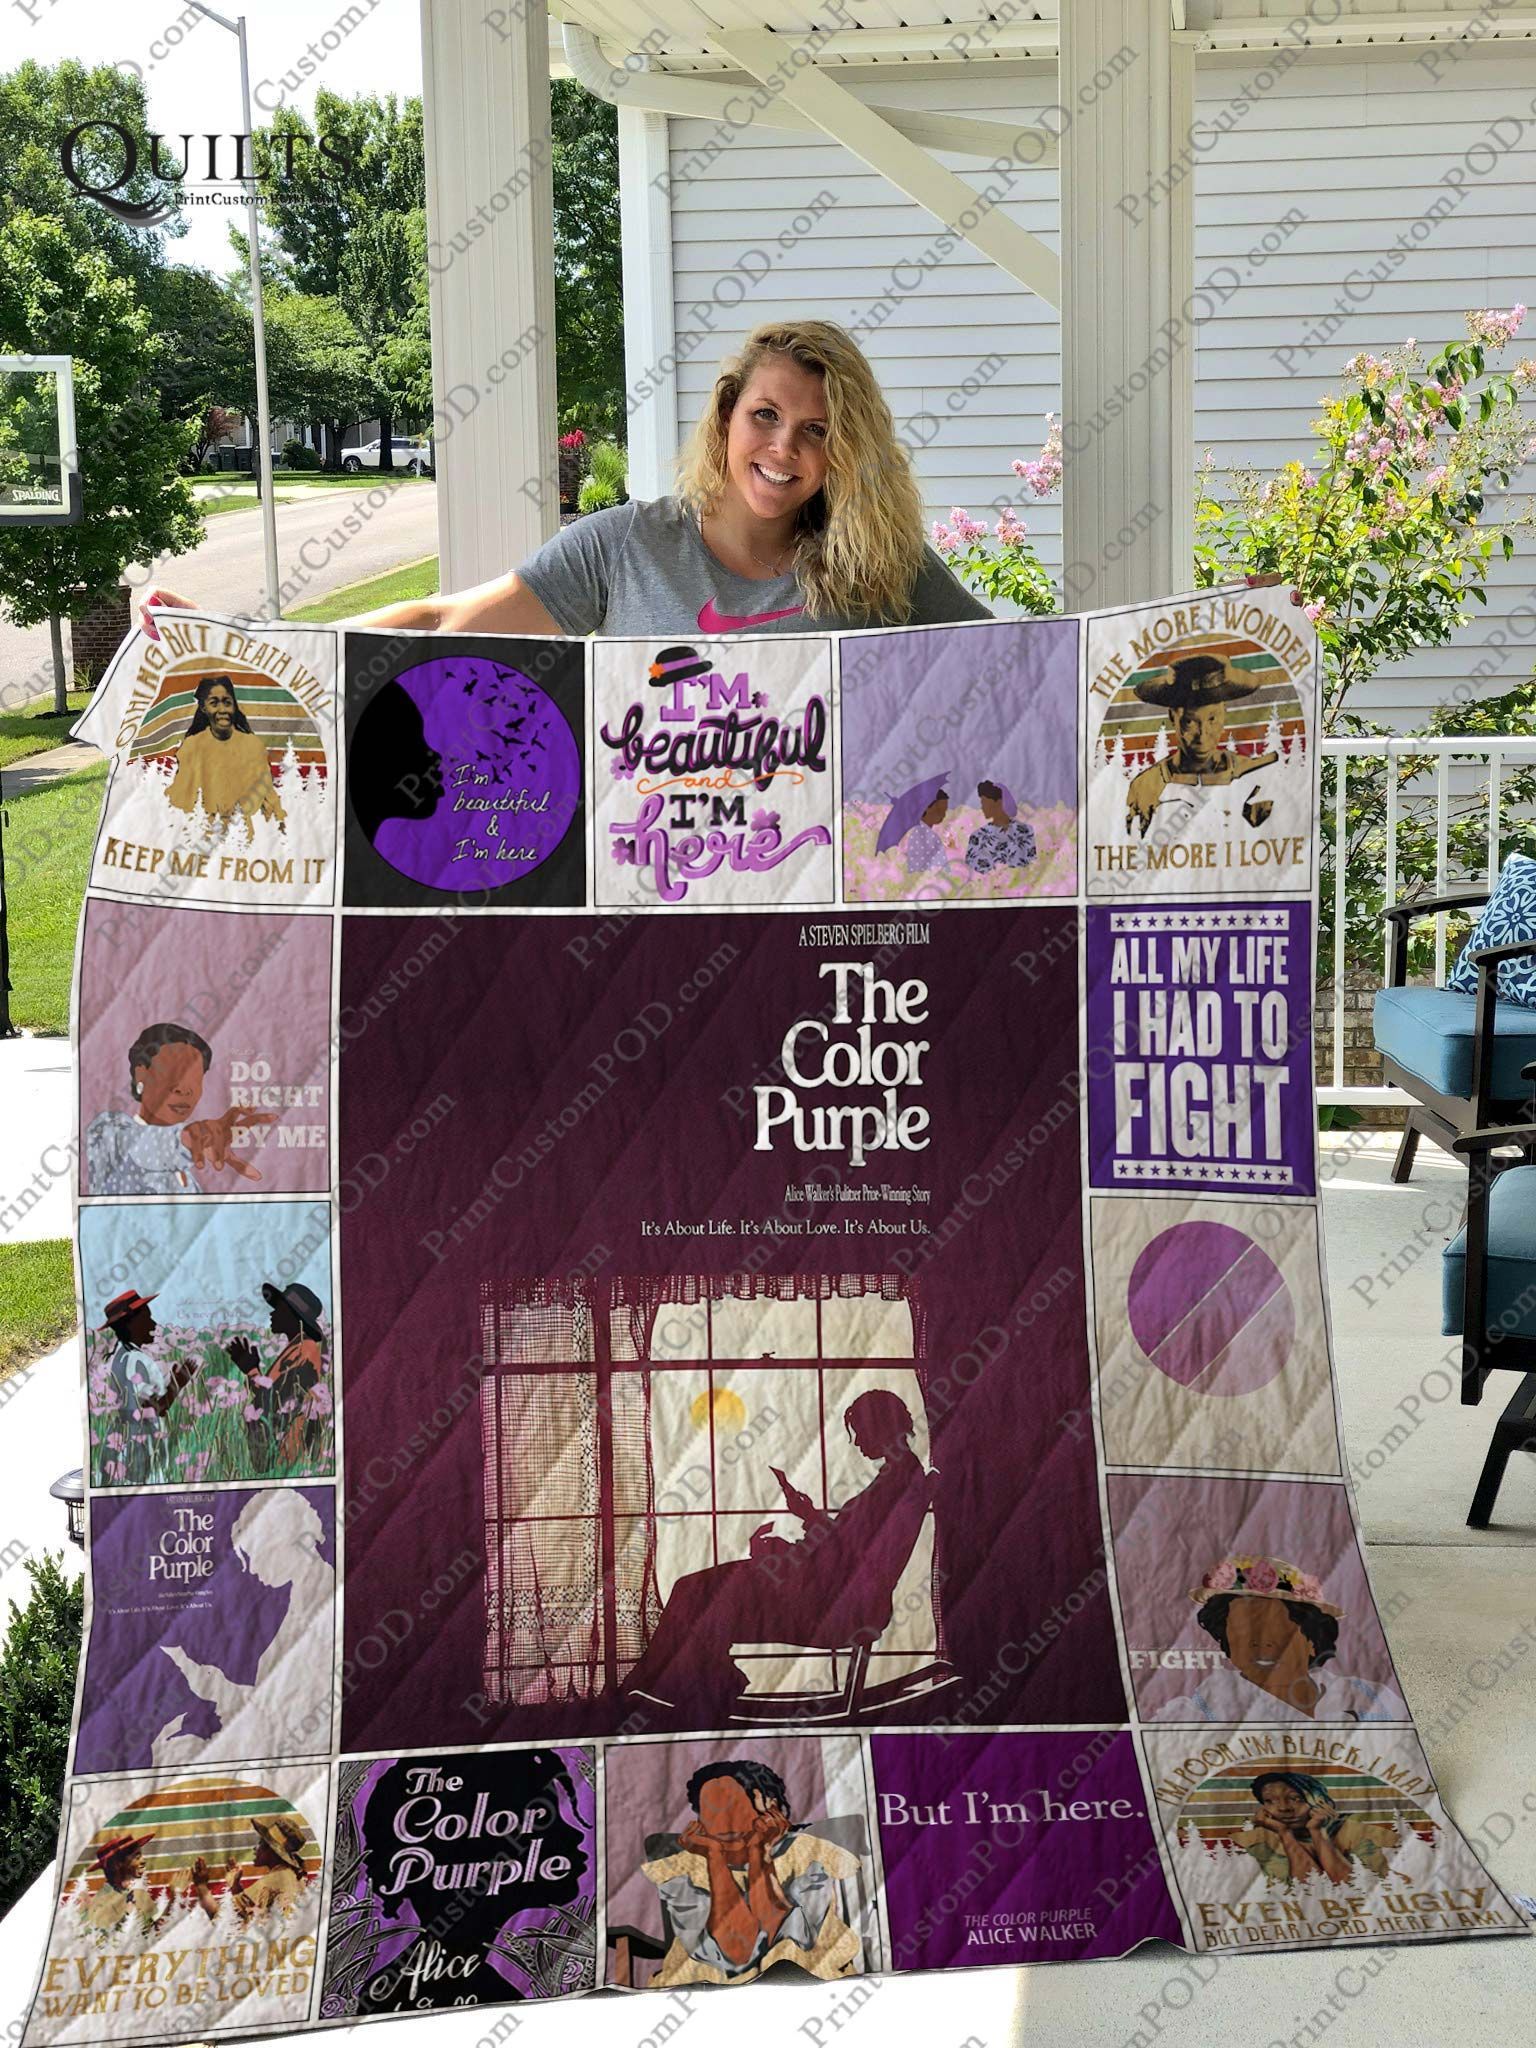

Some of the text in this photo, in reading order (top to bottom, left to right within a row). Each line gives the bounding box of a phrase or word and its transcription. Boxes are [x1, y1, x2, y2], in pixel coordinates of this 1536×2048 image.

[12, 489, 60, 502] SPALDING
[1089, 653, 1133, 700] THE
[1129, 605, 1201, 661] MORE
[1224, 600, 1312, 677] WONDER
[160, 622, 211, 659] BUT
[223, 631, 292, 678] DEATH
[289, 663, 332, 718] WILL
[600, 694, 827, 792] beautiful
[452, 763, 488, 787] I'm
[453, 788, 550, 814] beautiful
[669, 792, 748, 829] I'M
[486, 815, 499, 836] &
[102, 836, 325, 884] KEEP ME FROM IT
[452, 838, 537, 862] I'm here
[609, 793, 832, 902] here
[1094, 837, 1304, 871] THE MORE I LOVE
[798, 922, 930, 946] A STEVEN SPIELBERG FILM
[1110, 936, 1289, 985] ALL MY LIFE
[818, 961, 930, 1025] The
[1113, 990, 1289, 1060] I HAD TO
[230, 1060, 271, 1082] DO
[781, 1020, 930, 1088] Color
[230, 1086, 323, 1108] RIGHT
[1114, 1061, 1290, 1160] FIGHT
[230, 1125, 326, 1148] BY ME
[752, 1085, 931, 1167] Purple
[641, 1218, 931, 1236] It's About Life. It's About Love. It's About Us.
[173, 1508, 214, 1532] The
[159, 1530, 214, 1556] Color
[148, 1554, 214, 1584] Purple
[1129, 1650, 1228, 1670] FIGHT
[405, 1766, 464, 1794] The
[1381, 1768, 1437, 1797] MAY
[393, 1792, 547, 1844] Color
[878, 1790, 1145, 1826] But I'm here.
[379, 1838, 572, 1896] Purple
[964, 1907, 1092, 1927] THE COLOR PURPLE
[1196, 1887, 1488, 1927] EVEN BE UGLY
[967, 1922, 1098, 1946] ALICE WALKER
[1204, 1926, 1240, 1948] BUT
[1248, 1923, 1300, 1943] DEAR
[1377, 1914, 1432, 1934] HERE
[369, 1940, 480, 2001] Alice
[44, 1972, 310, 2018] WANT TO BE LOVED
